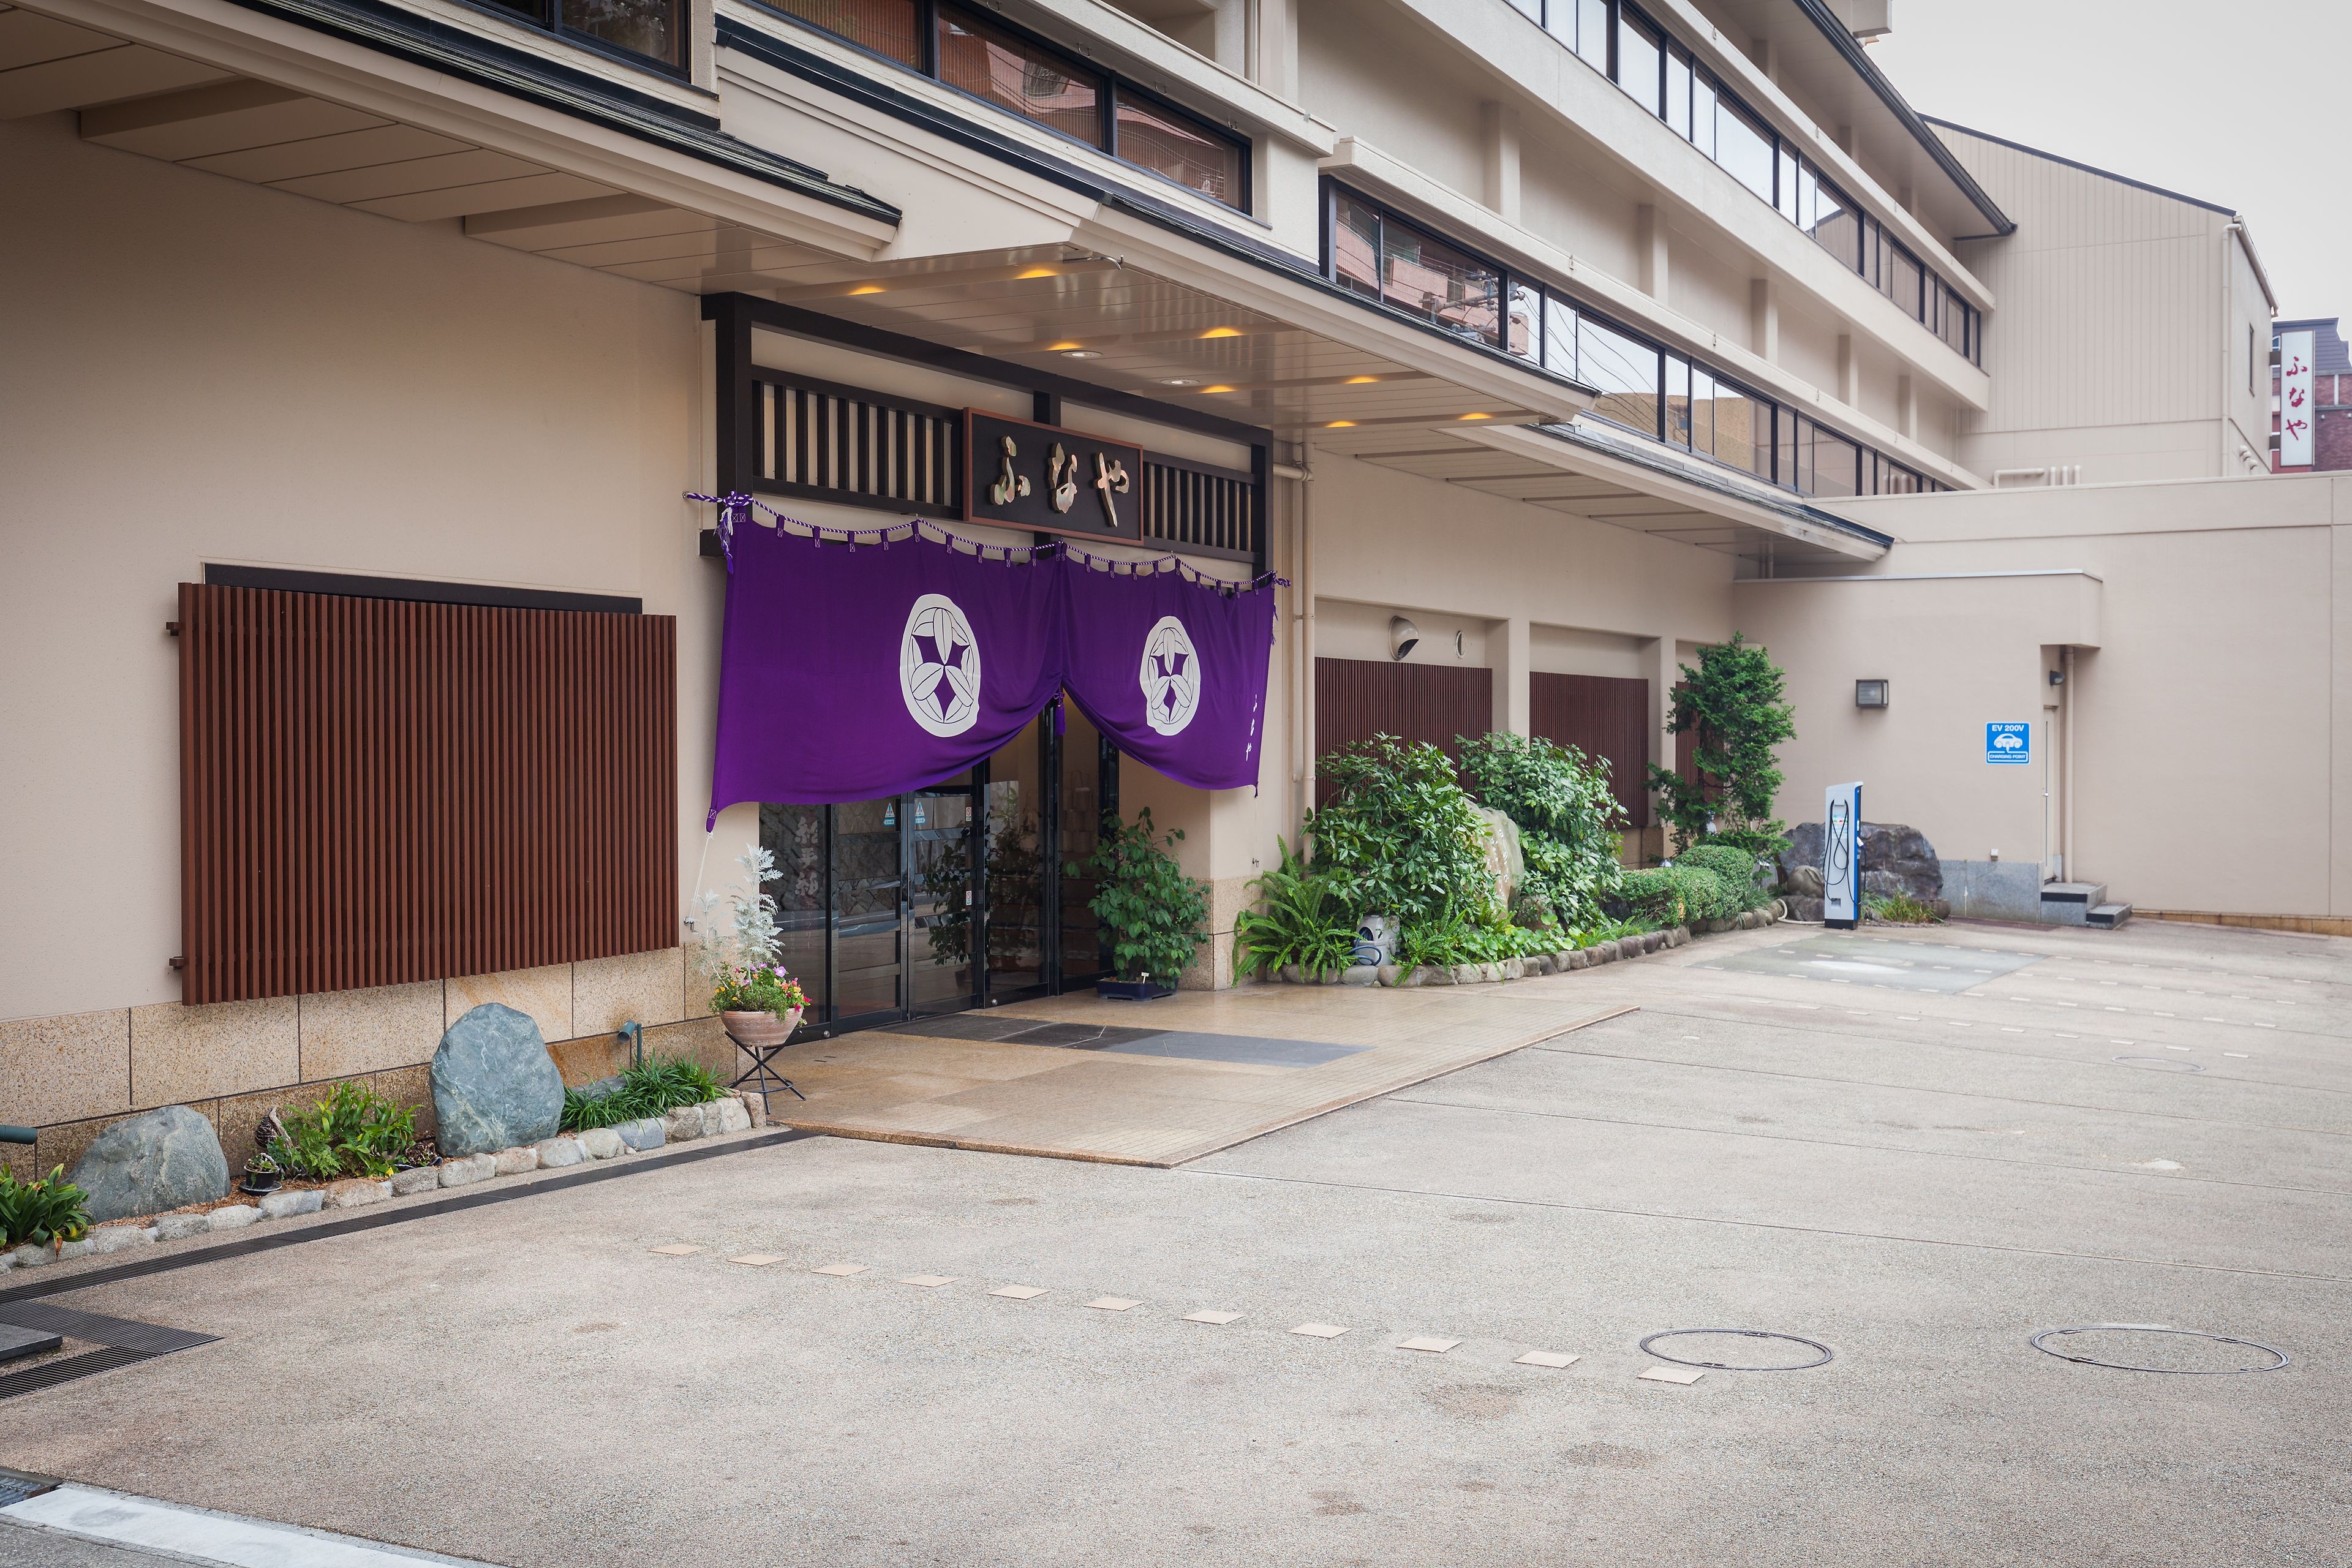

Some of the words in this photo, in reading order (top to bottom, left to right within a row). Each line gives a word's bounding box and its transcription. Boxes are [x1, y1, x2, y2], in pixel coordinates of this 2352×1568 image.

[2285, 356, 2308, 441] ふなや
[989, 435, 1130, 528] ふなや
